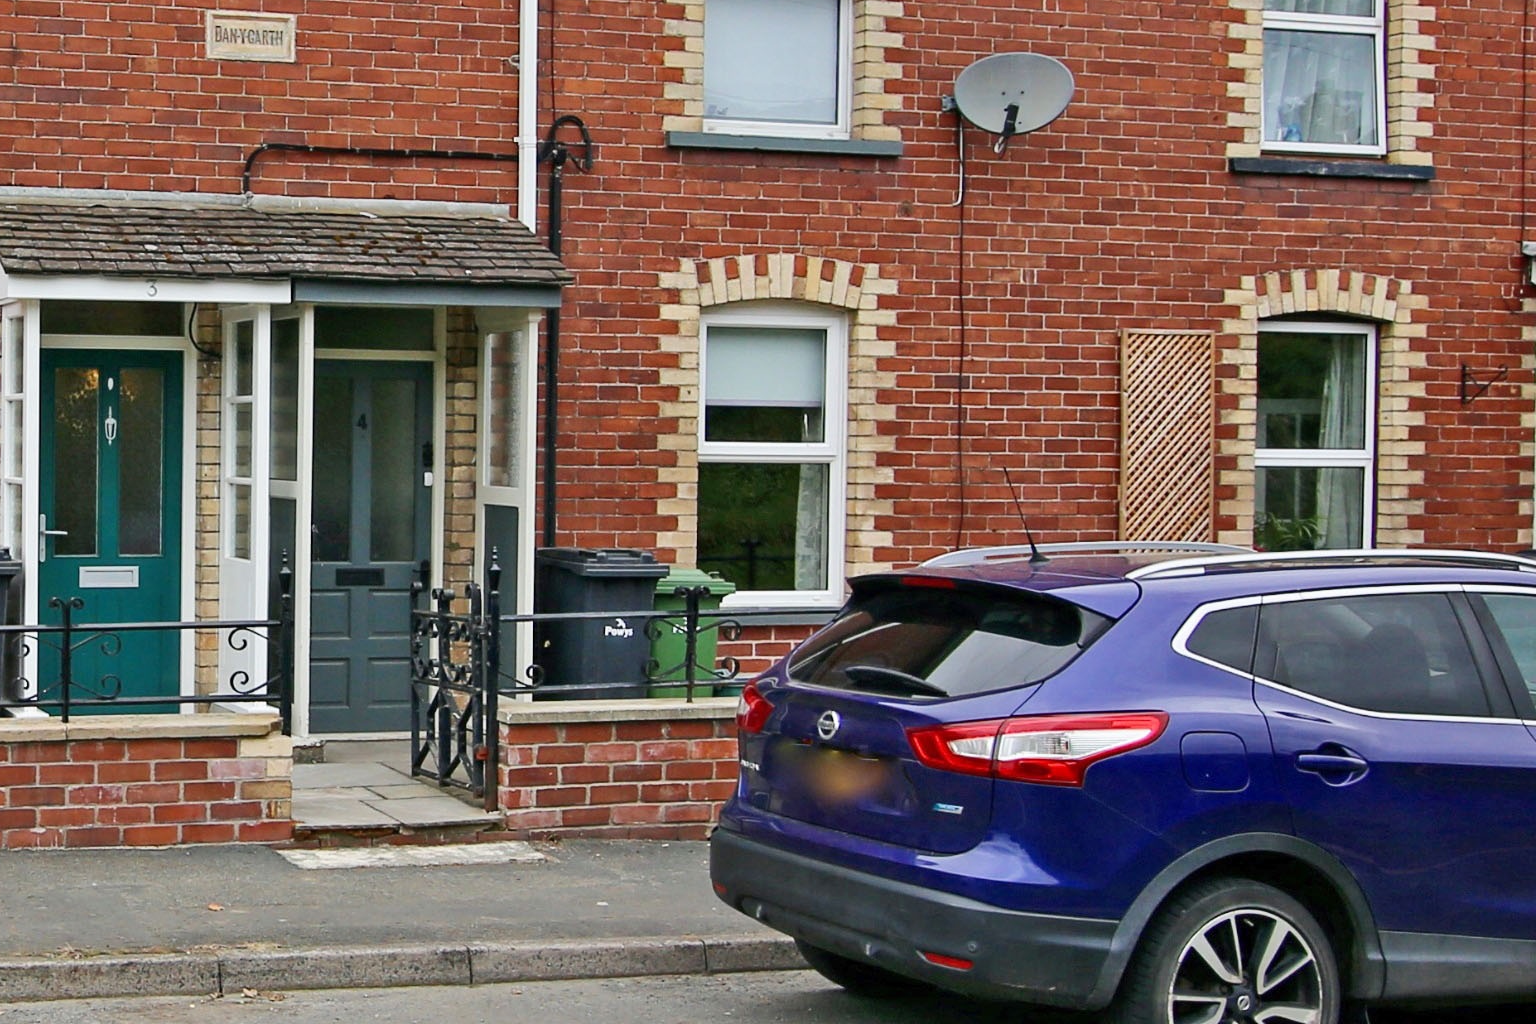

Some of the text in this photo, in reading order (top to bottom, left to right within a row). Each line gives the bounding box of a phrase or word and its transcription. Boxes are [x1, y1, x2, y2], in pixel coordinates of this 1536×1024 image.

[145, 278, 158, 297] 3
[357, 413, 367, 430] 4
[604, 625, 634, 638] Powys
